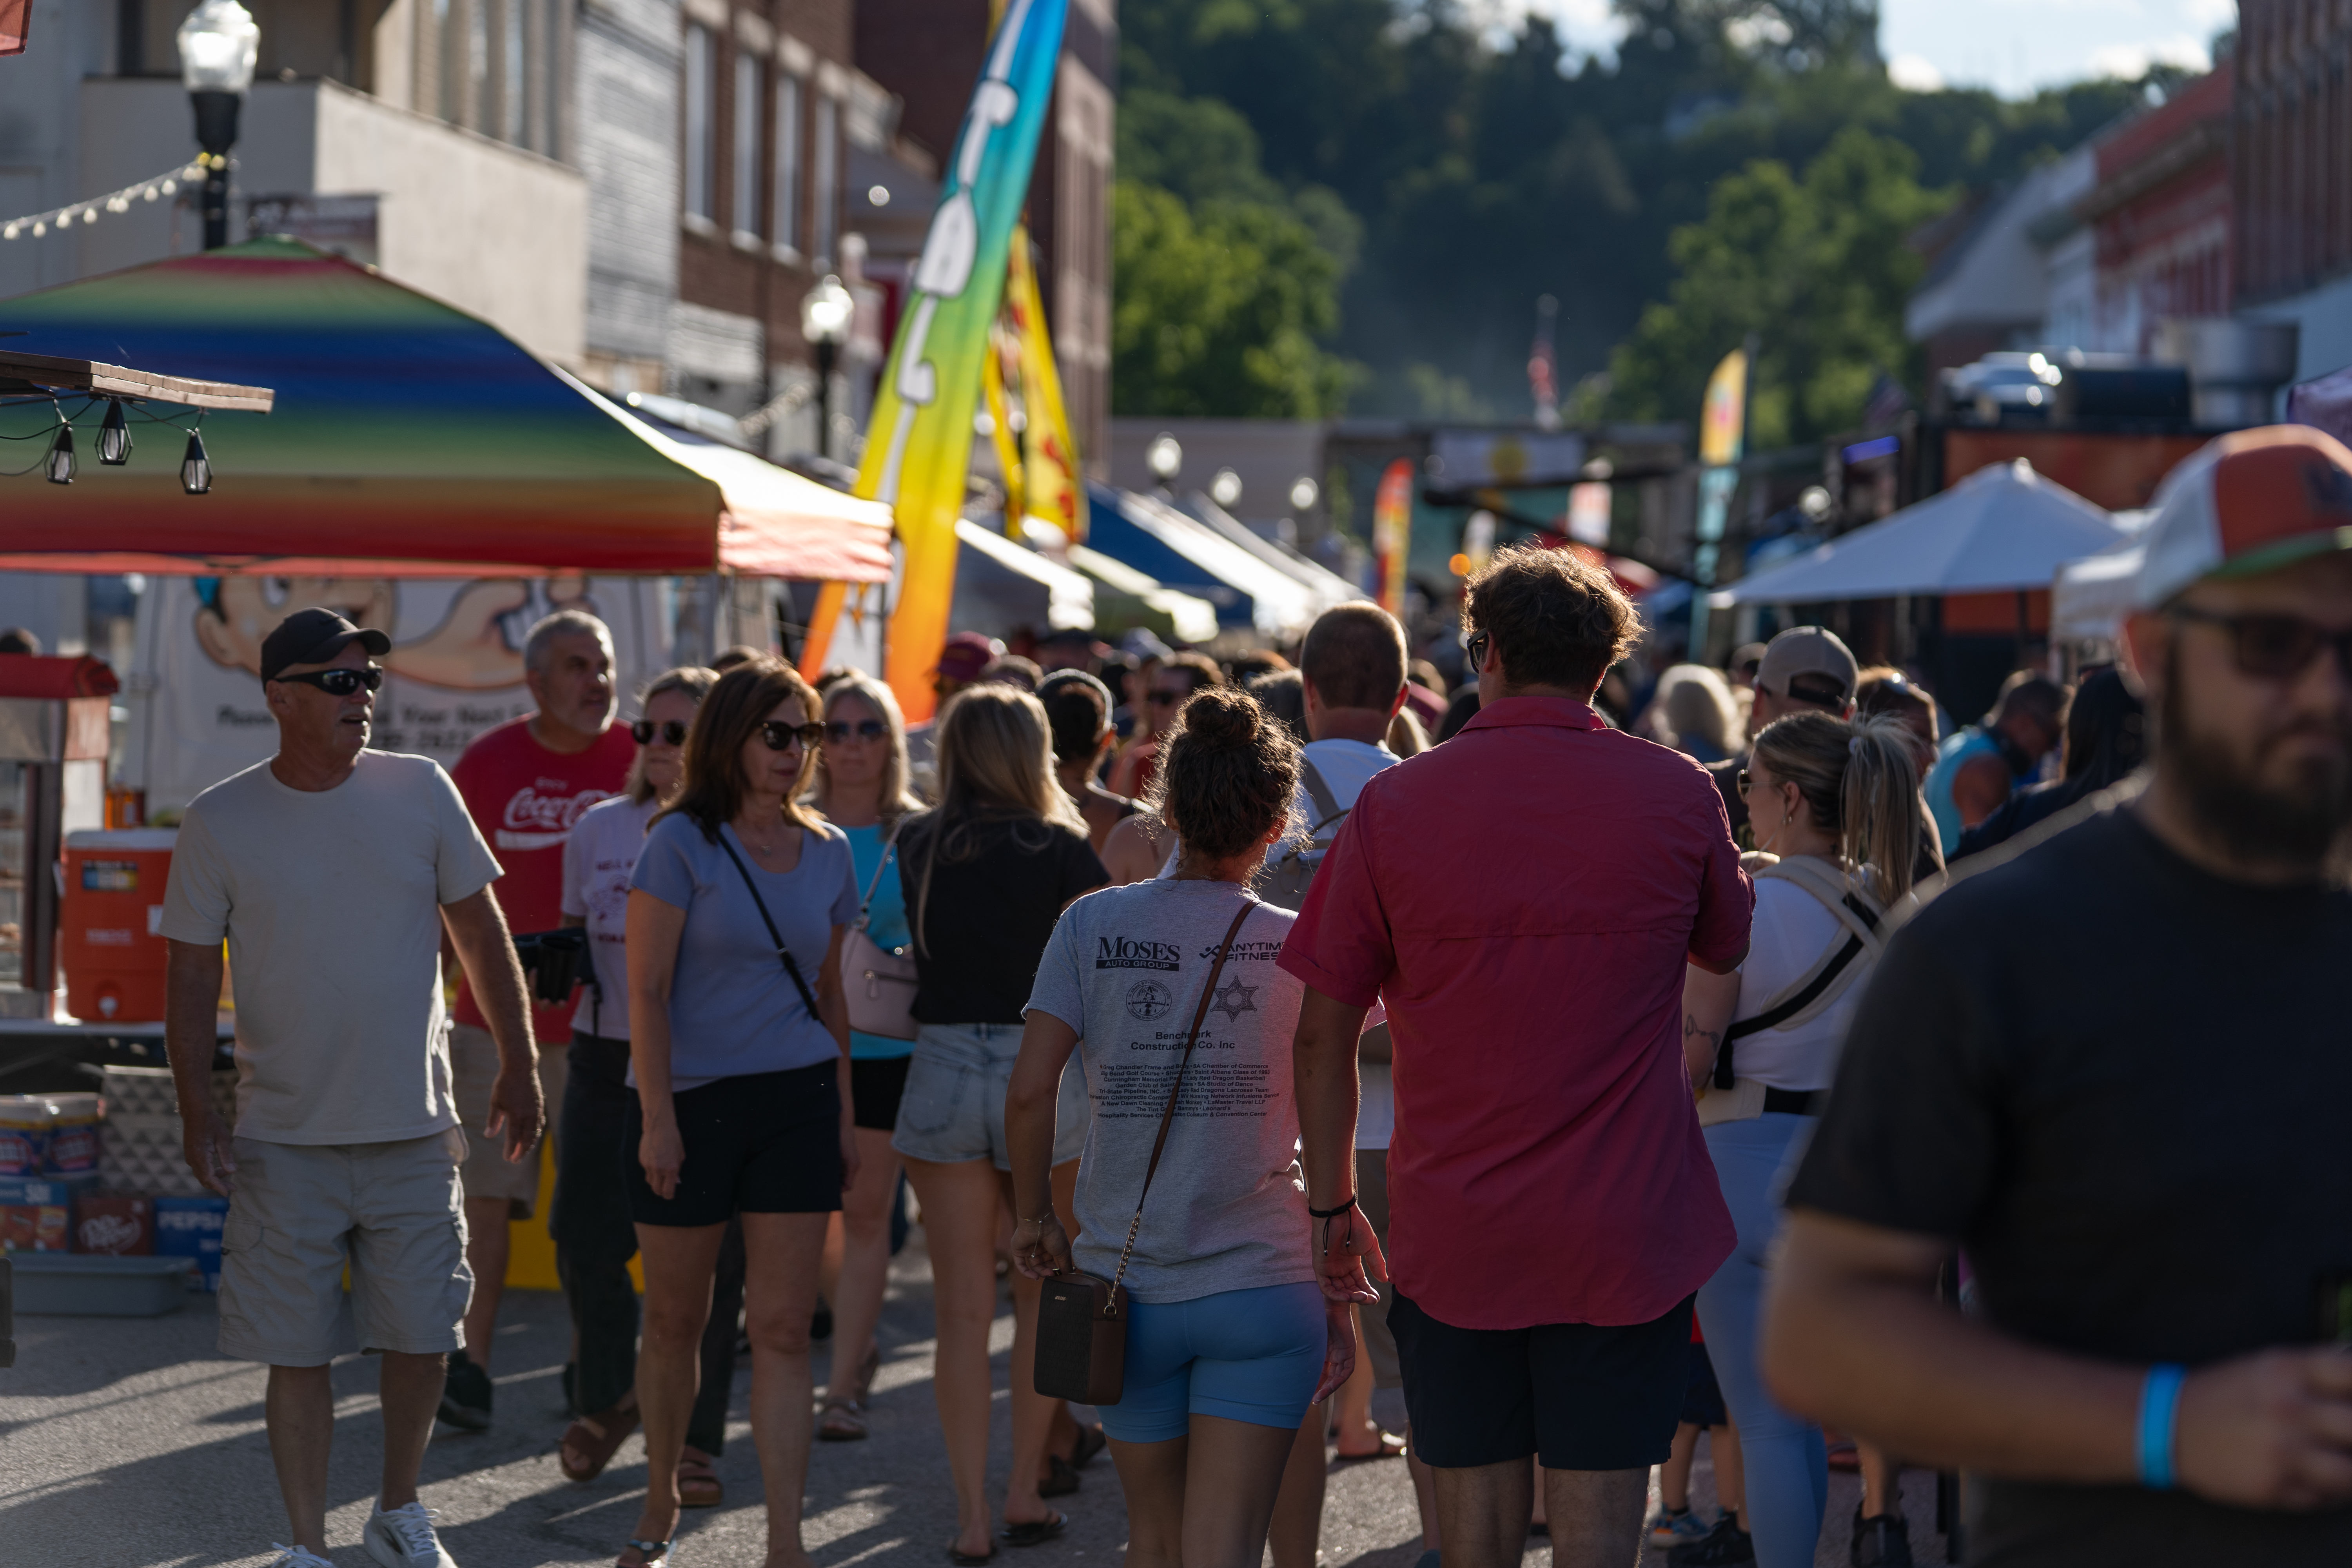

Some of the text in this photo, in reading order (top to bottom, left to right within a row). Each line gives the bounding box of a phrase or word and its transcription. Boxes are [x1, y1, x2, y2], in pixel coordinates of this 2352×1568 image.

[1096, 936, 1180, 962] MOSES
[1228, 942, 1285, 952] ANYTIM
[1225, 952, 1279, 963] FITNES
[1198, 1041, 1215, 1049] Co.
[1219, 1041, 1235, 1049] Inc
